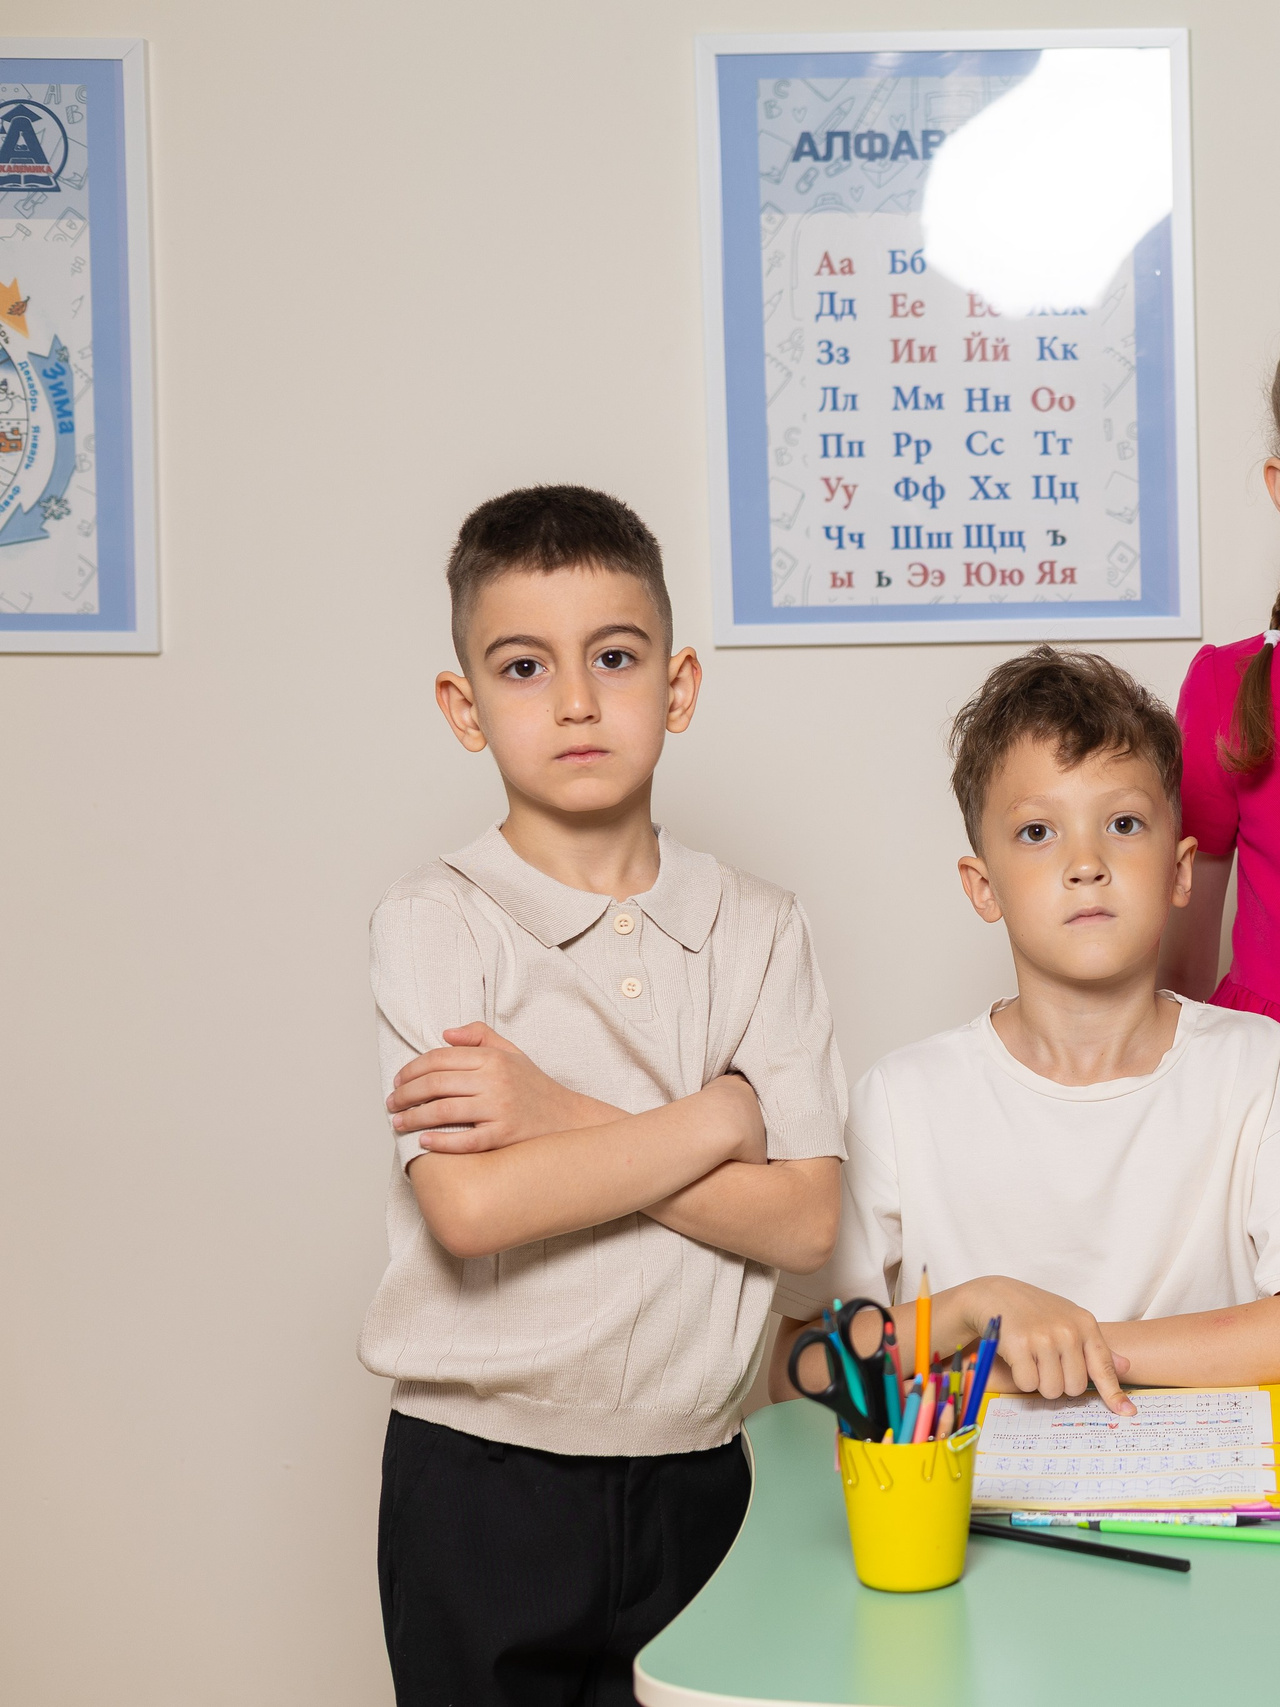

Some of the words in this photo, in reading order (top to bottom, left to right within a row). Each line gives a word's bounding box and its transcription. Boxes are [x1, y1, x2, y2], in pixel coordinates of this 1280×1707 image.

[792, 130, 946, 162] АЛФАВ
[815, 251, 854, 275] Аа
[888, 249, 926, 274] Бб
[816, 292, 856, 321] Дд
[890, 293, 924, 318] Ее
[817, 340, 850, 364] Зз
[891, 339, 936, 363] Ии
[964, 332, 1009, 362] Йй
[1038, 337, 1078, 360] Кк
[18, 360, 38, 412] Декабрь
[43, 362, 75, 435] Зима
[819, 387, 857, 411] Лл
[893, 386, 943, 410] Мм
[966, 388, 1010, 412] Нн
[1031, 387, 1075, 412] Оо
[24, 425, 41, 470] Январь
[820, 434, 864, 458] Пп
[894, 433, 932, 464] Рр
[966, 431, 1003, 456] Сс
[1035, 431, 1072, 455] Тт
[0, 486, 21, 514] Февр
[821, 477, 858, 509] Уу
[894, 476, 945, 509] Фф
[970, 476, 1010, 500] Хх
[1033, 475, 1078, 504] Цц
[824, 526, 864, 549] Чч
[892, 526, 951, 549] Шш
[964, 524, 1025, 553] Щщ
[908, 563, 945, 587] Ээ
[964, 562, 1024, 586] Юю
[1036, 561, 1076, 584] Яя
